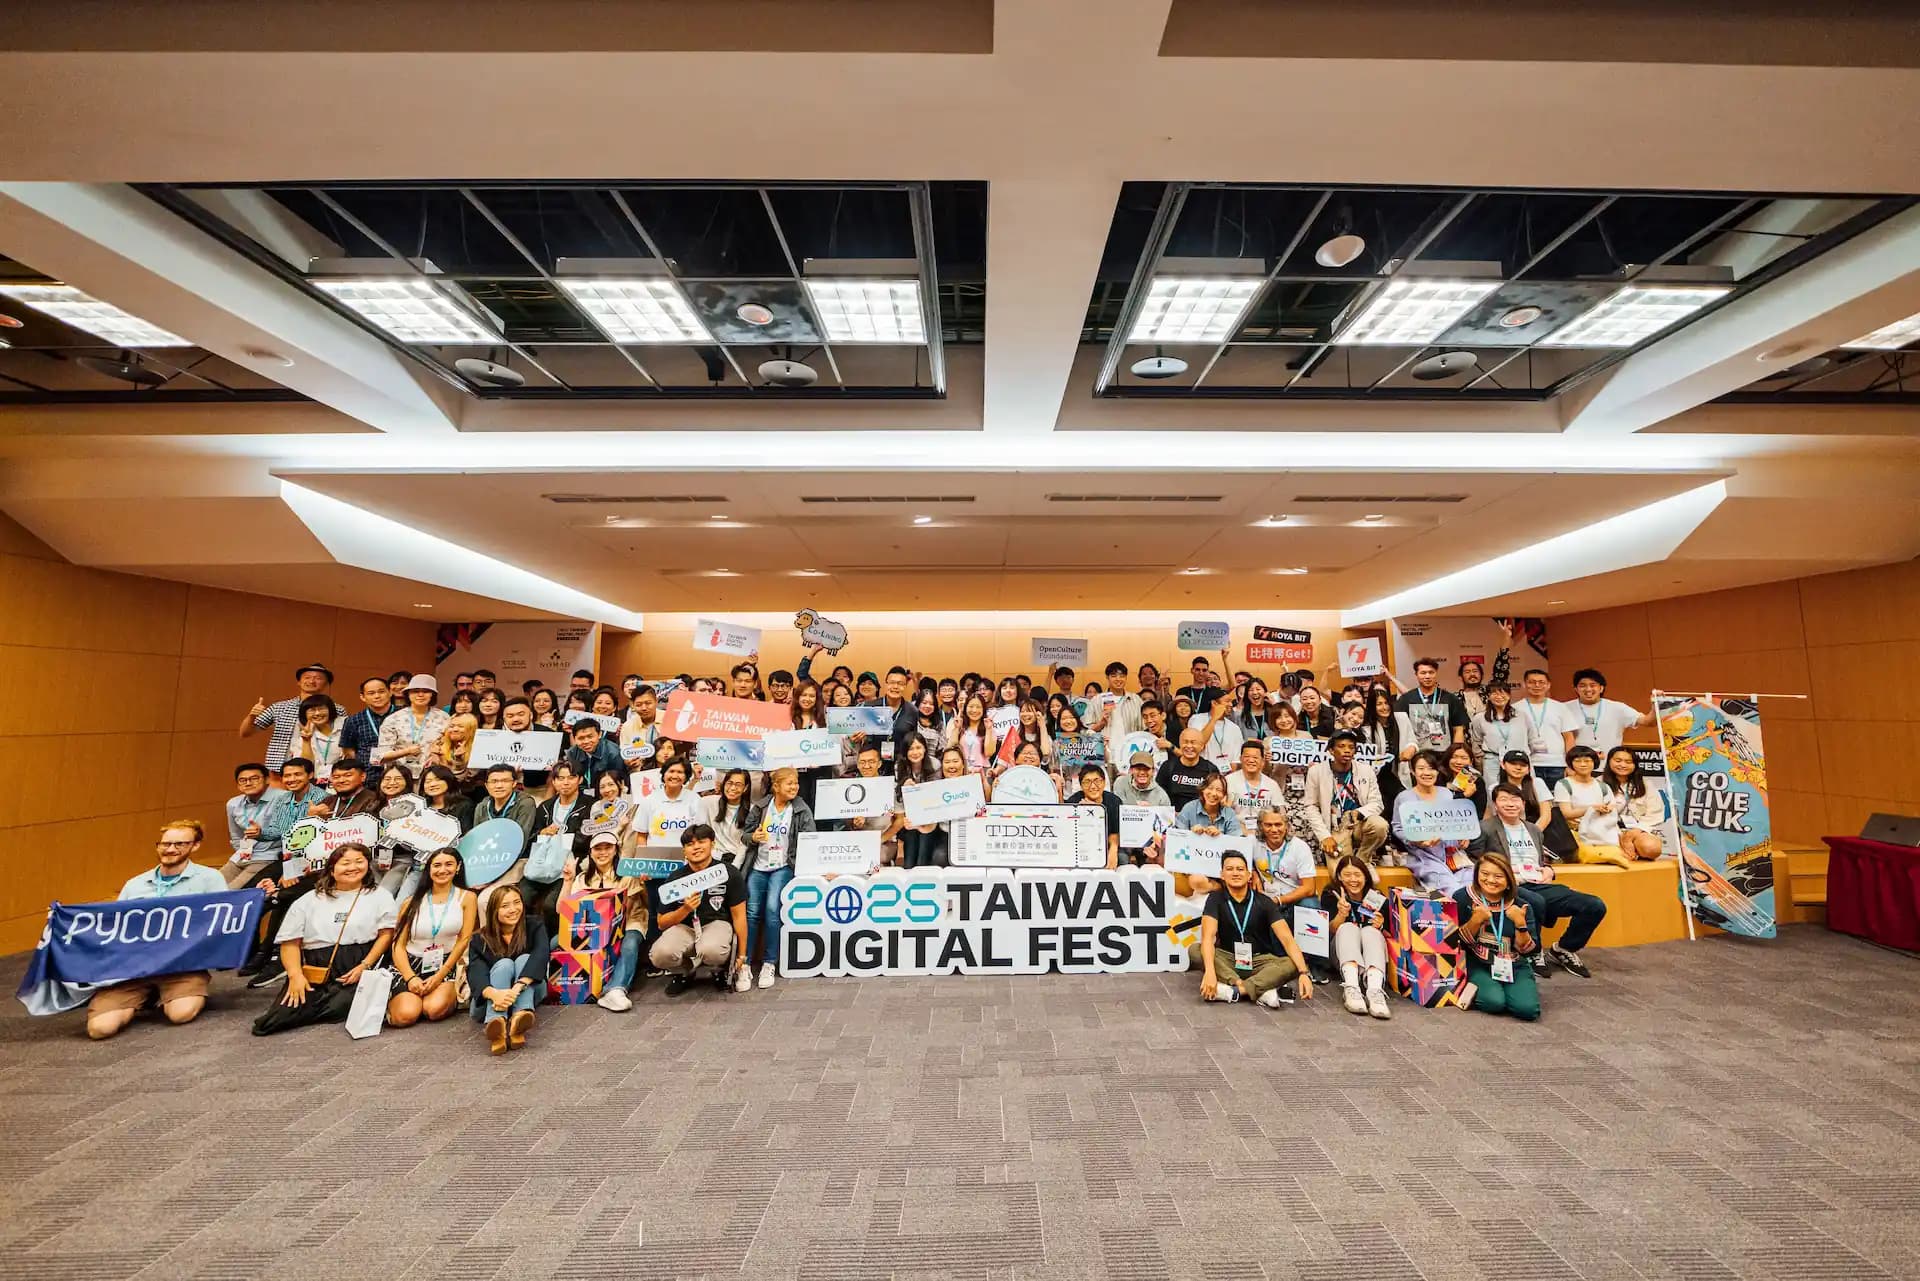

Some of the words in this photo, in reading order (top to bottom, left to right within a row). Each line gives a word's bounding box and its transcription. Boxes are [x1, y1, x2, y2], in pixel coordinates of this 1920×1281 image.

[1193, 627, 1227, 636] NOMAD
[1271, 632, 1293, 641] HOYA
[1294, 634, 1307, 642] BIT
[1039, 645, 1082, 654] OpenCulture
[1346, 665, 1365, 673] HOYA
[705, 709, 750, 723] TAIWAN
[702, 718, 742, 733] DIGITAL
[992, 718, 1019, 730] RYPTO
[1691, 771, 1729, 790] CO
[1689, 790, 1750, 811] LIVE
[1424, 808, 1472, 819] NOMAD
[660, 819, 688, 830] dna
[1688, 808, 1752, 833] FUK.
[985, 824, 1058, 838] TDNA
[818, 845, 862, 854] TDNA
[467, 852, 512, 865] OMAD
[623, 860, 679, 872] NOMAD
[680, 869, 722, 889] NOMAD
[946, 880, 1166, 921] TAIWAN
[62, 905, 190, 945] PYCON
[203, 901, 254, 936] TW
[787, 928, 1013, 970] DIGITAL
[1029, 925, 1181, 966] FEST.
